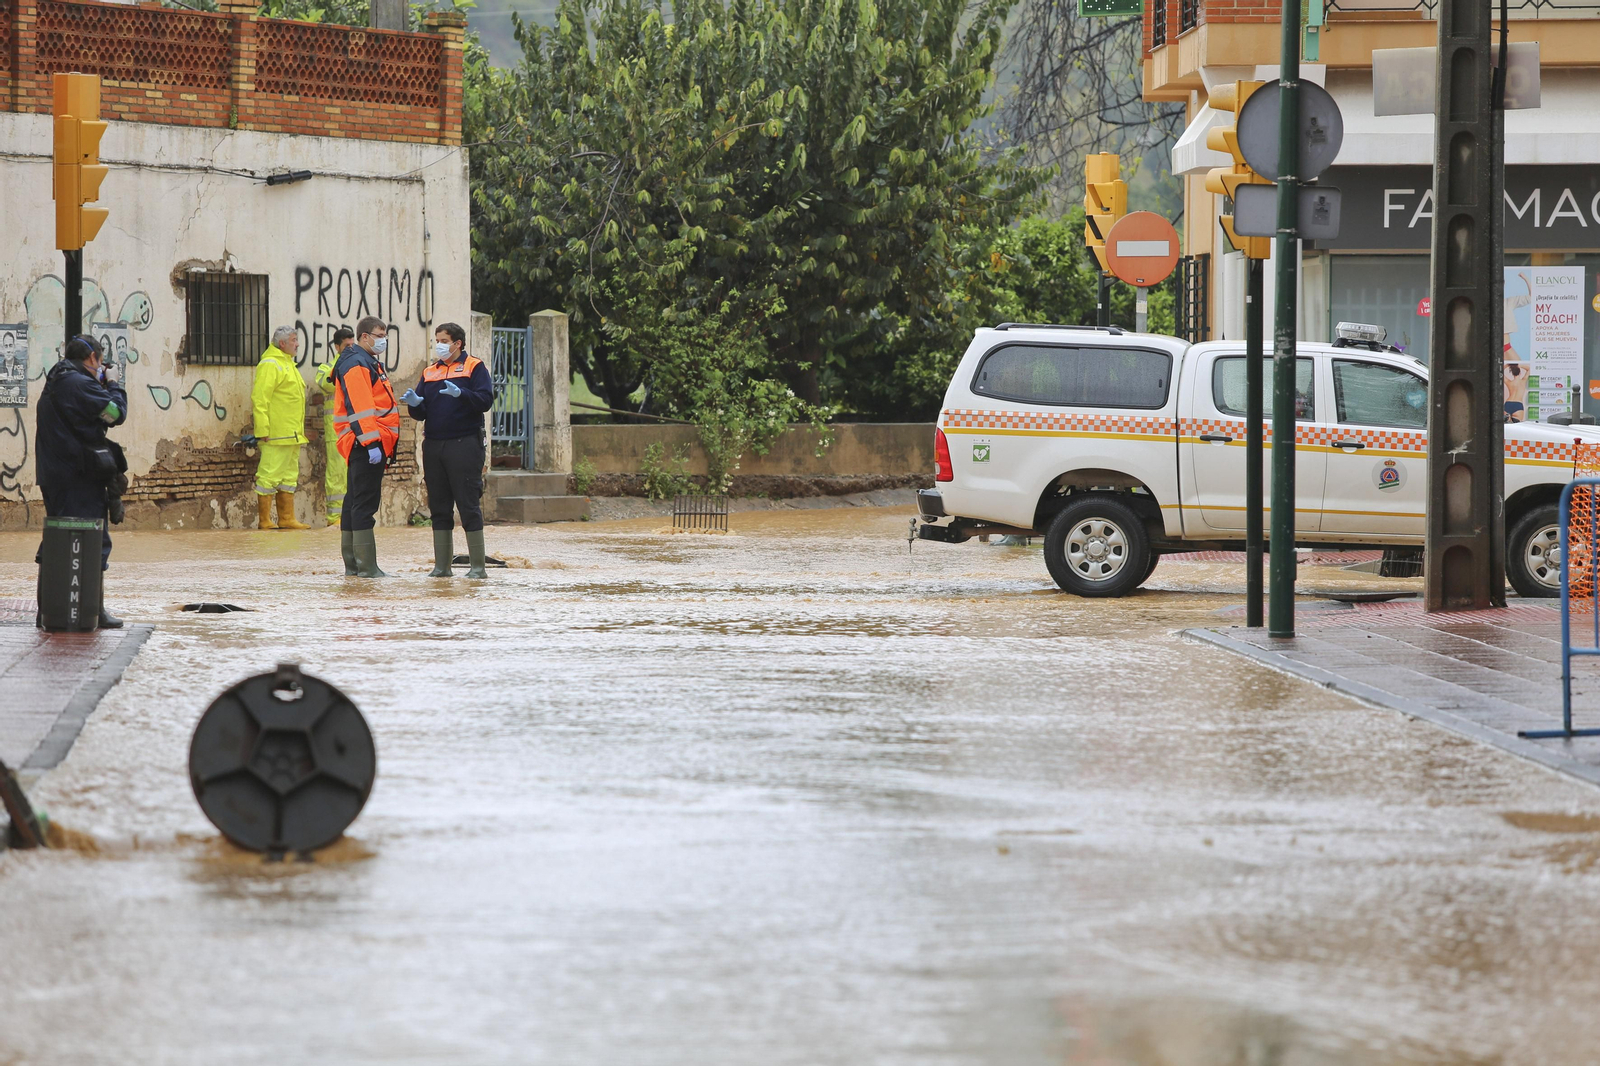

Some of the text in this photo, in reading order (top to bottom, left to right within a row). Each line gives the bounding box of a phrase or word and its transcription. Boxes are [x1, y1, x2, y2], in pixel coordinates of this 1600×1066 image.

[1383, 188, 1600, 229] FAMA
[1535, 276, 1578, 285] ELANCYL
[294, 266, 434, 328] PROXIMO
[1535, 304, 1552, 313] MY
[1535, 314, 1577, 324] COACH!
[1535, 351, 1548, 359] X4
[70, 539, 80, 619] ÚSAME
